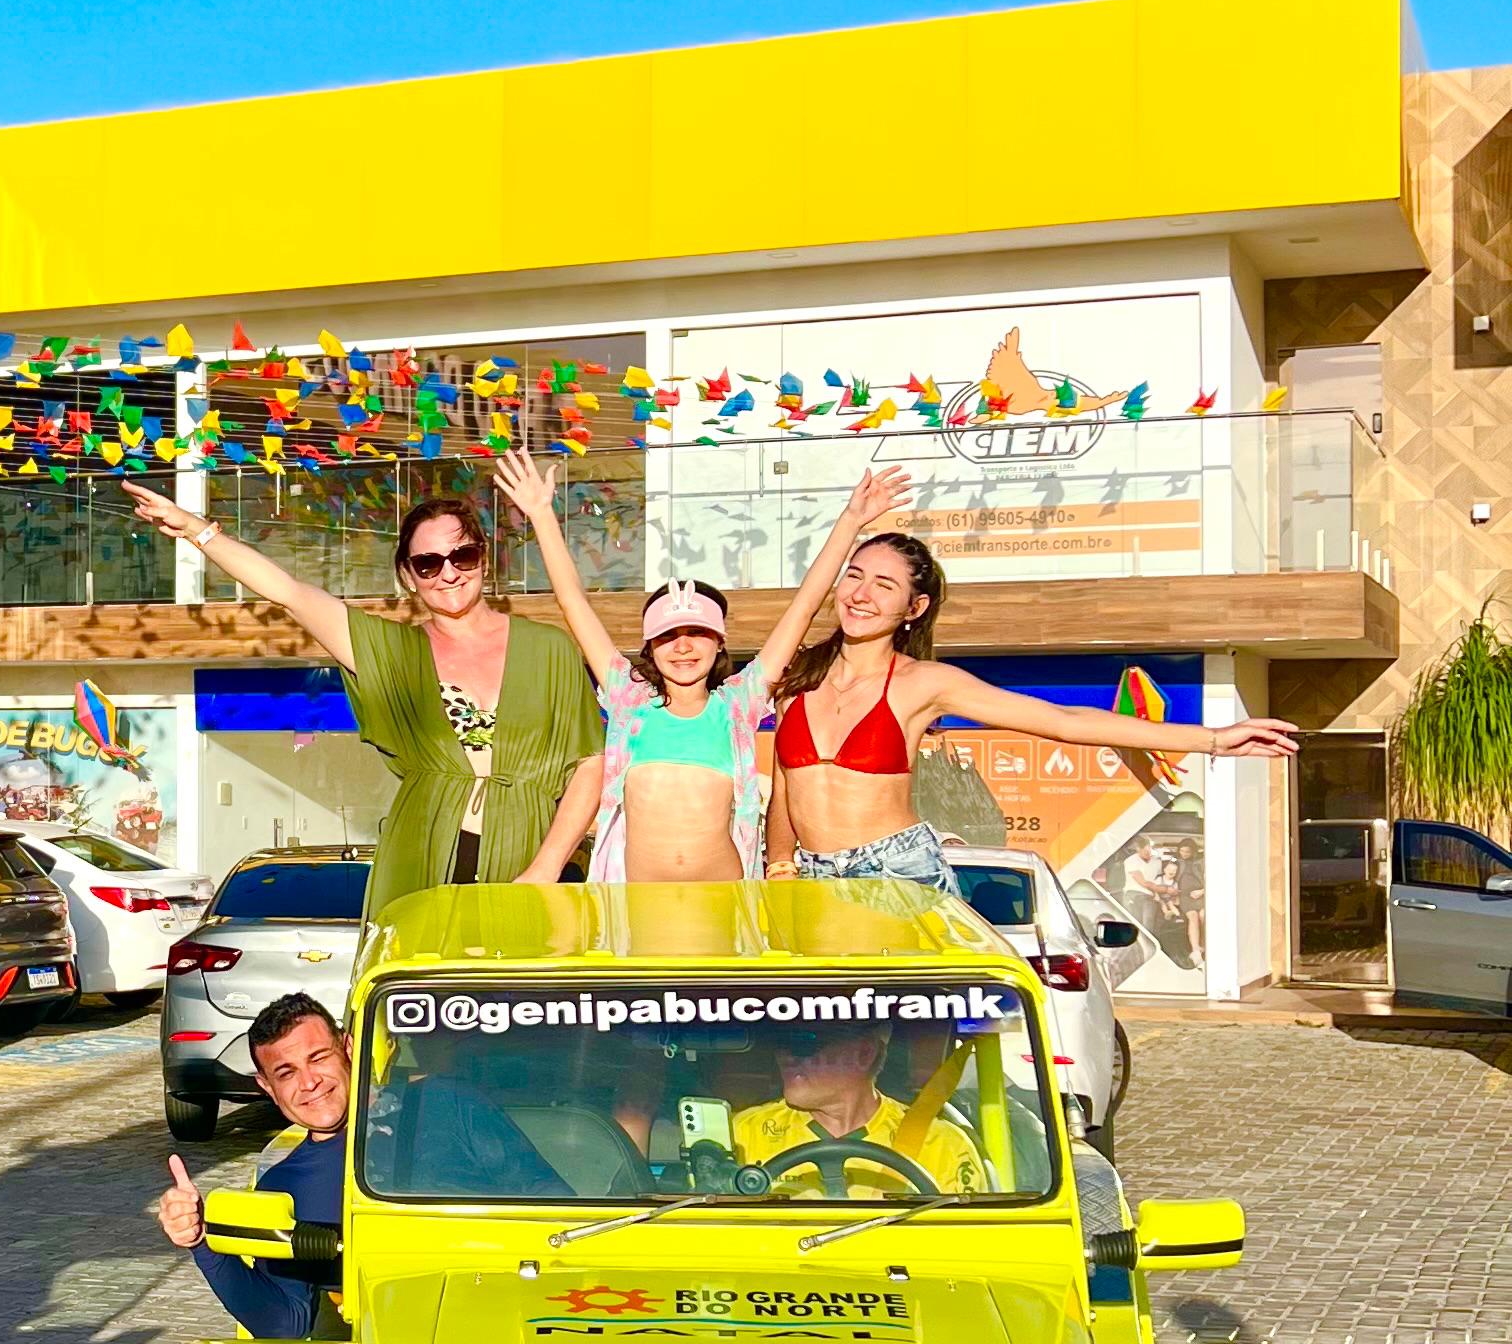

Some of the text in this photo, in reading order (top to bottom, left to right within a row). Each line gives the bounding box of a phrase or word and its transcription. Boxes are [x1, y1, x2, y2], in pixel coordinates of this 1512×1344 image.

[962, 420, 1093, 457] CIEM
[947, 513, 974, 529] (61)
[31, 721, 149, 767] BUGY
[440, 987, 1007, 1033] @genipabucomfrank
[675, 1289, 907, 1307] RIO GRANDE
[675, 1302, 909, 1319] DO NORTE
[536, 1326, 916, 1343] NATAL
